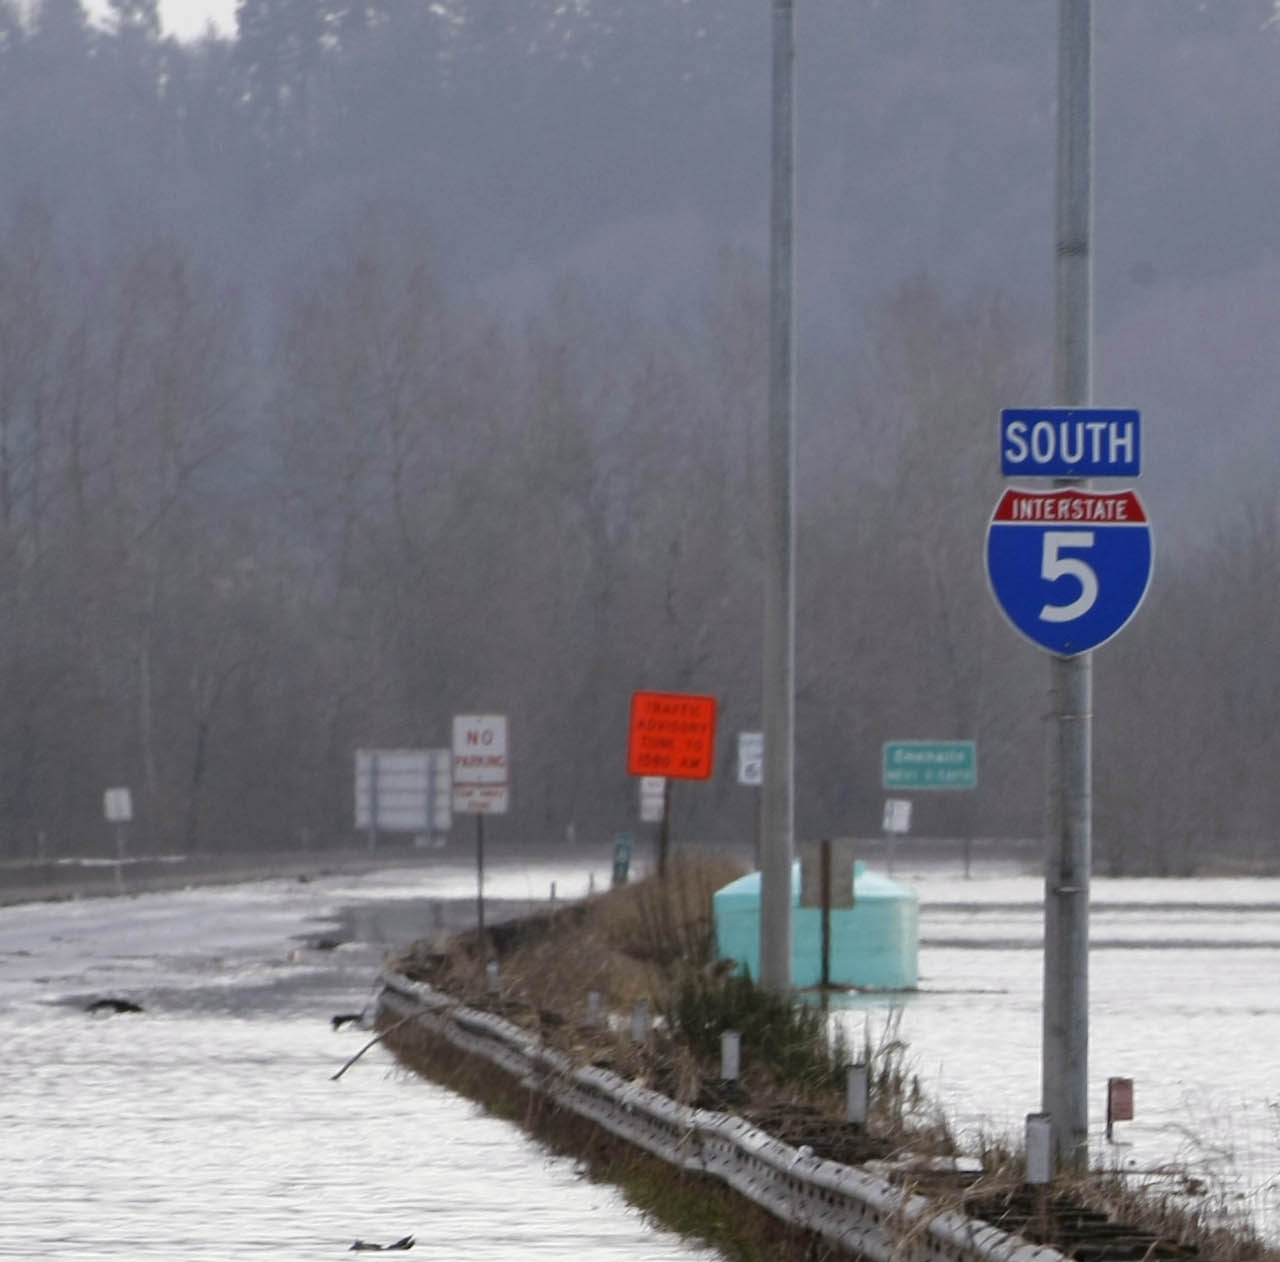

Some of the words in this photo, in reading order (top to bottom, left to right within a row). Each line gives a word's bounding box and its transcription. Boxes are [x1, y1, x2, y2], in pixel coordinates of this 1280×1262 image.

[1005, 421, 1134, 464] SOUTH
[1012, 498, 1129, 520] INTERSTATE
[1039, 531, 1099, 623] 5
[467, 729, 493, 745] NO
[455, 754, 505, 768] PARKING
